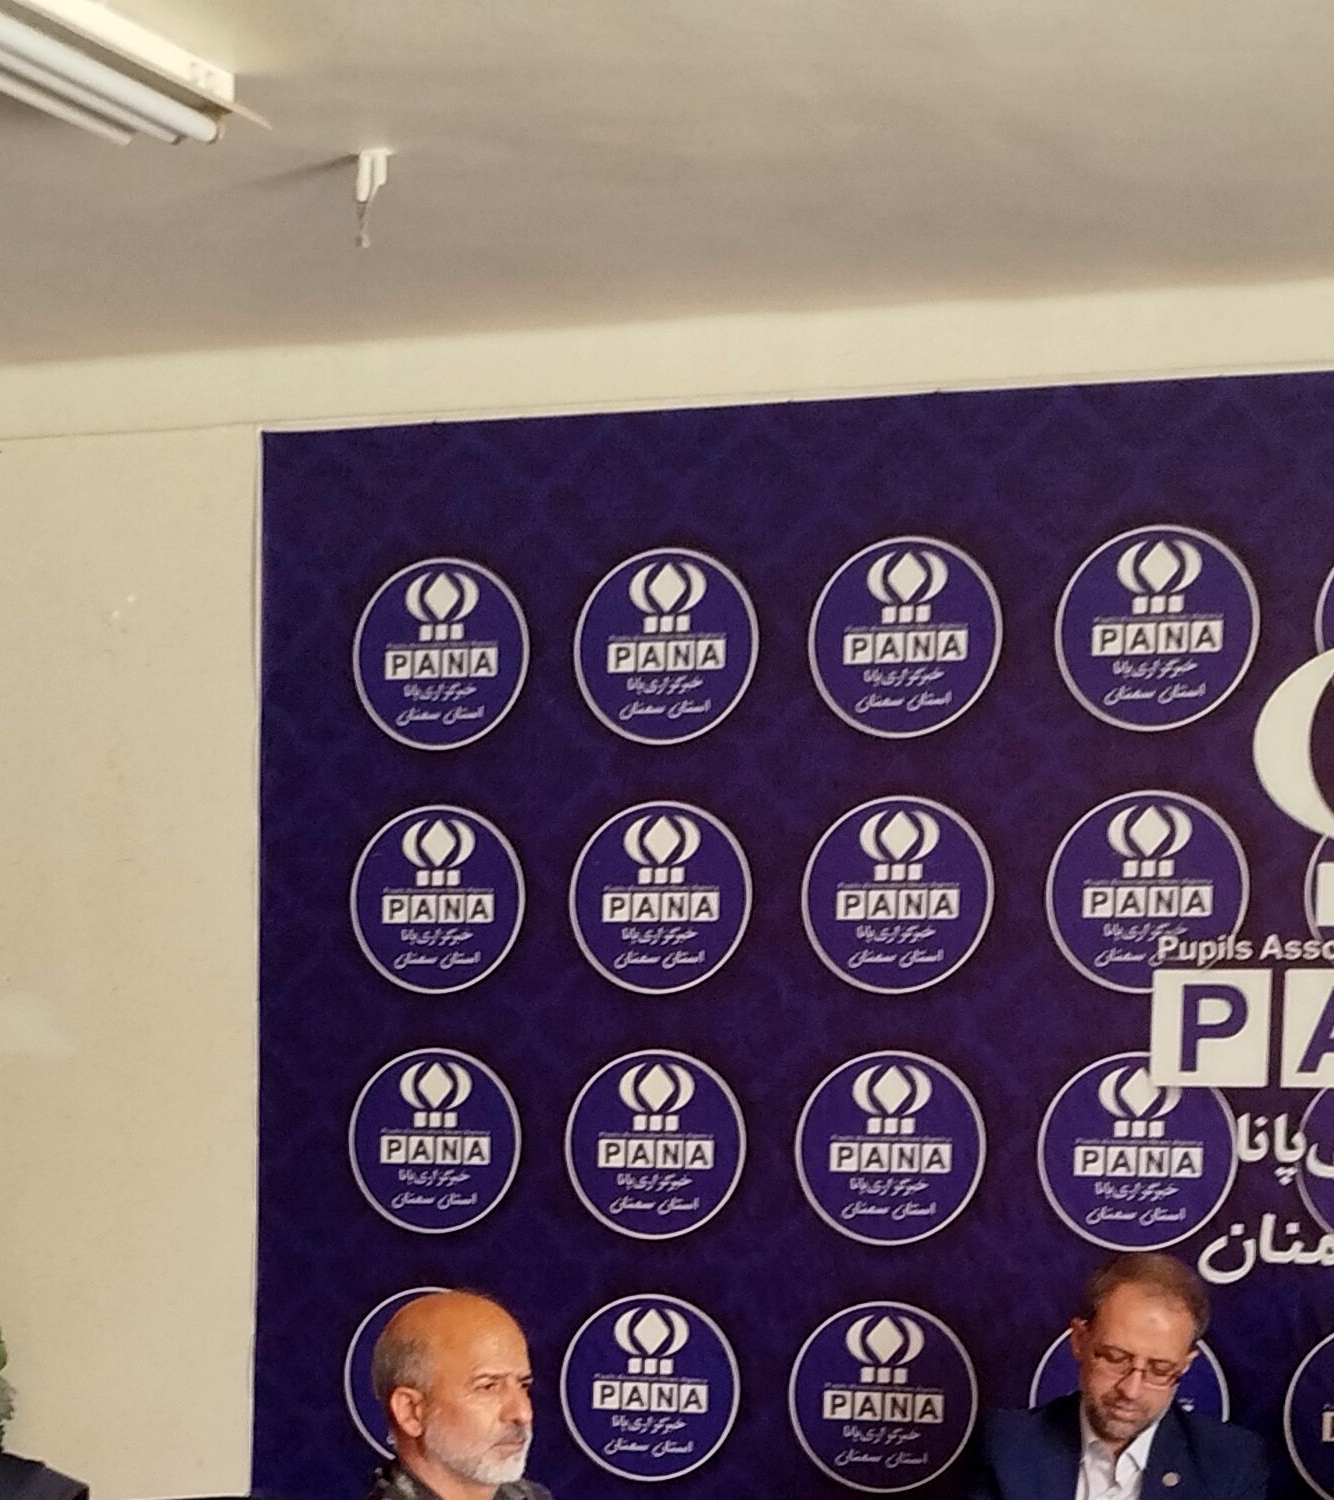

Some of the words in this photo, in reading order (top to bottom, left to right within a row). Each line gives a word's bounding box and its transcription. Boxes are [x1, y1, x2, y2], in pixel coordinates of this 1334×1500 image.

[847, 631, 965, 663] PANA
[1096, 622, 1220, 654] PANA
[389, 649, 496, 678] PANA
[611, 641, 723, 671] PANA
[386, 896, 492, 922] PANA
[606, 894, 717, 921] PANA
[840, 891, 957, 919] PANA
[1087, 888, 1210, 917] PANA
[1157, 933, 1254, 966] Pupils
[384, 1137, 488, 1164] PANA
[601, 1140, 711, 1168] PANA
[833, 1144, 949, 1172] PANA
[1078, 1147, 1200, 1177] PANA
[1235, 1112, 1308, 1185] پانا
[596, 1382, 706, 1412] PANA
[827, 1391, 942, 1423] PANA
